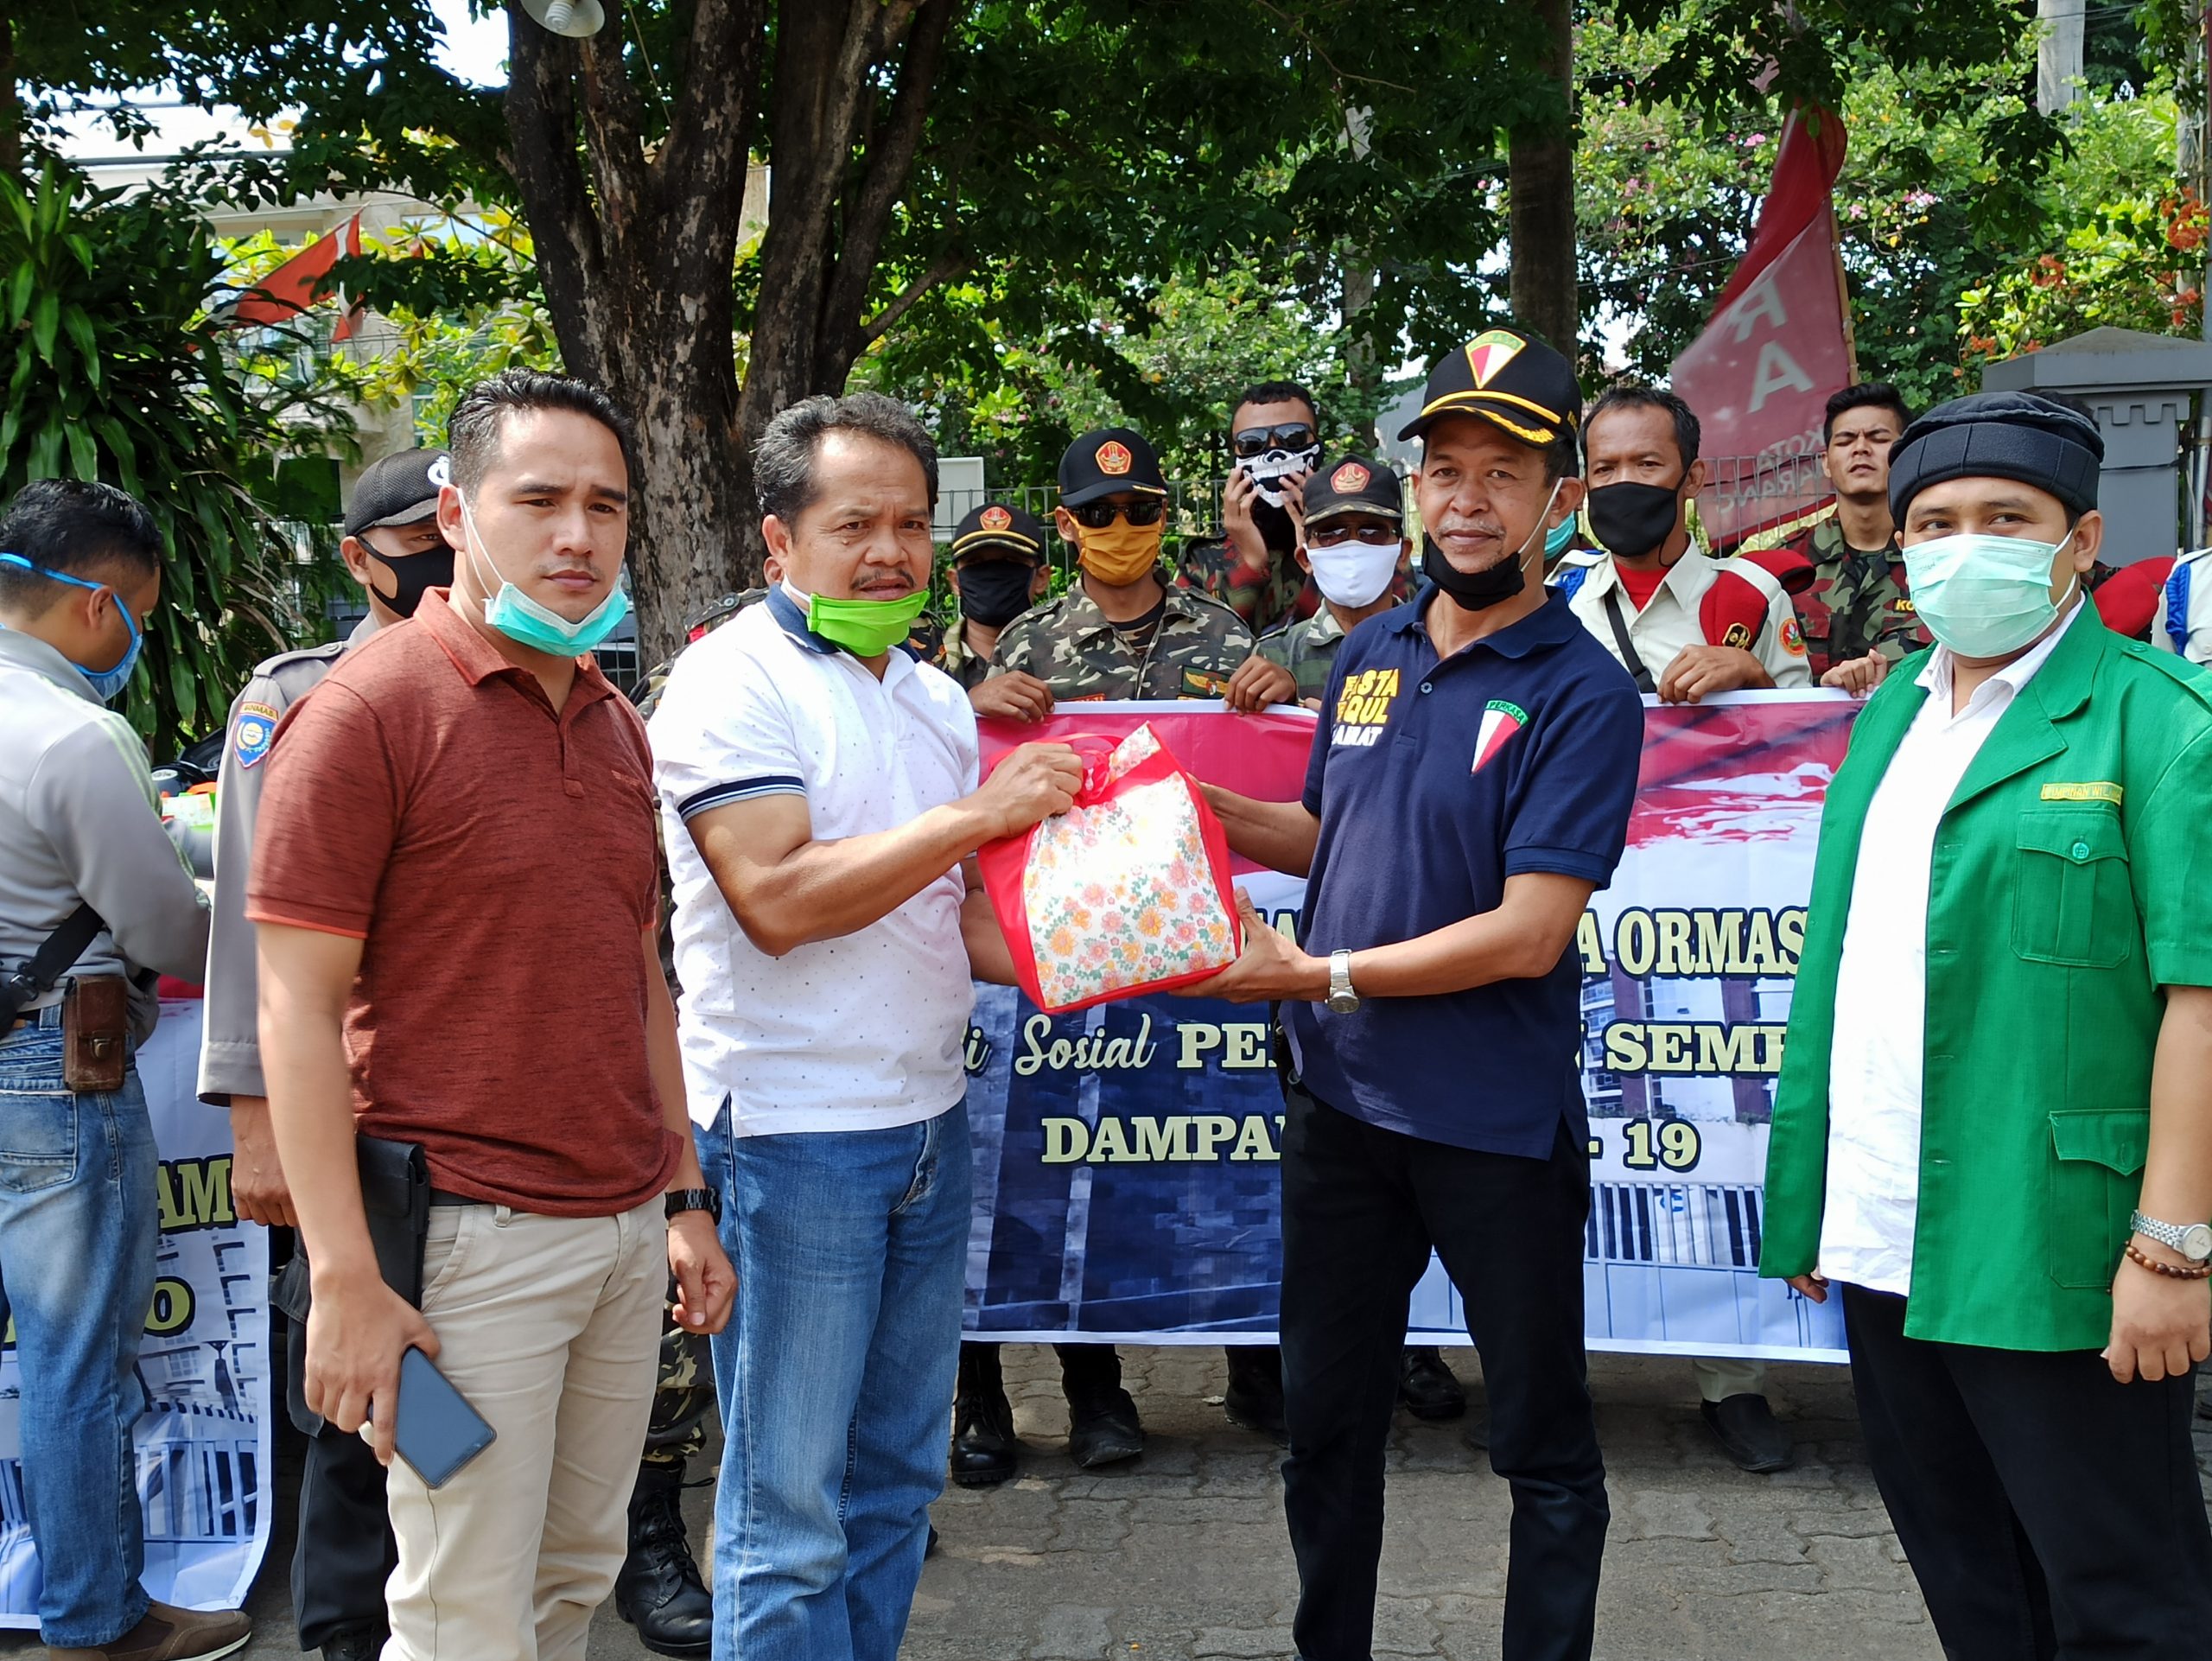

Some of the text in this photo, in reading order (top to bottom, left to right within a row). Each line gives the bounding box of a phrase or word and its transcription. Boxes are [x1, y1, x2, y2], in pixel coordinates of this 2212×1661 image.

[1577, 909, 1807, 975] A ORMAS
[1014, 1014, 1157, 1076] Sosial
[1176, 1023, 1277, 1068] PE
[1041, 1116, 1286, 1162] DAMPA
[1626, 1123, 1697, 1167] 19
